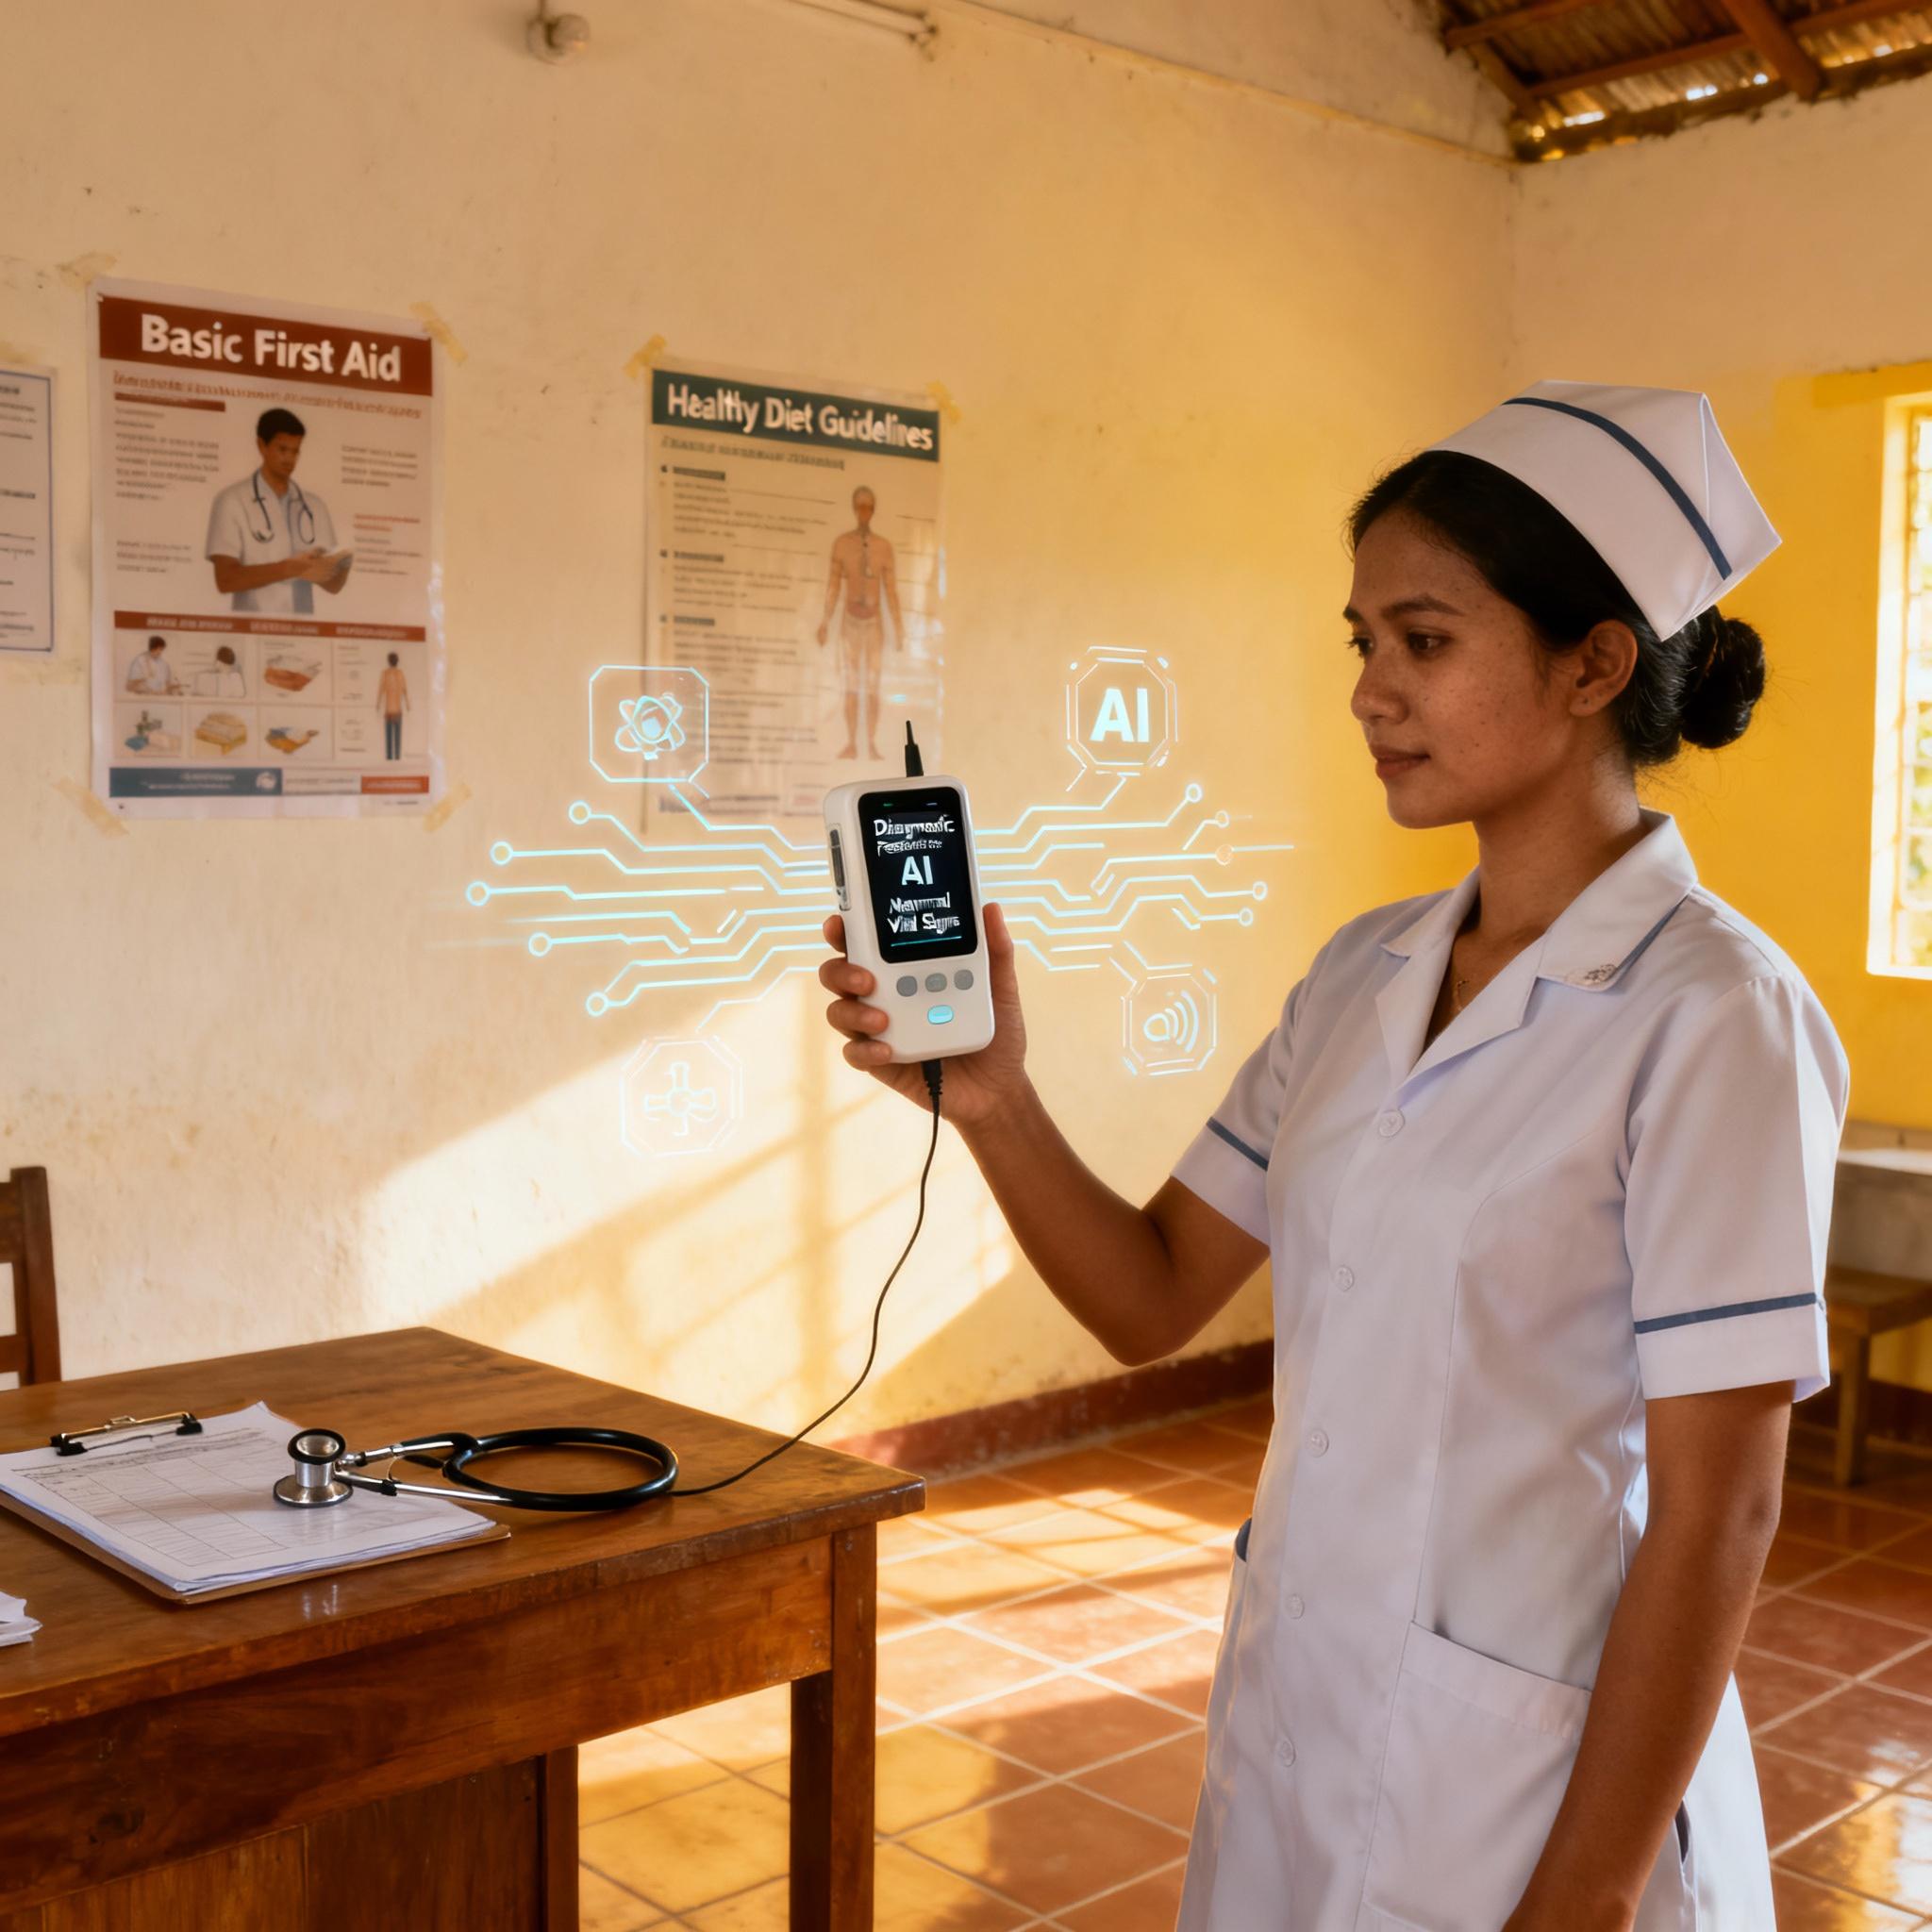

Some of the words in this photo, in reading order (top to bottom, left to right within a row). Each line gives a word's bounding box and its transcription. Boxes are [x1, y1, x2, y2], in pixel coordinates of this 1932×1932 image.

[142, 313, 242, 363] Basic
[255, 328, 335, 374] First
[341, 341, 402, 383] Aid
[667, 382, 760, 434] Healthy
[764, 396, 814, 434] Diet
[818, 405, 934, 451] Guidelines
[901, 855, 935, 886] AI
